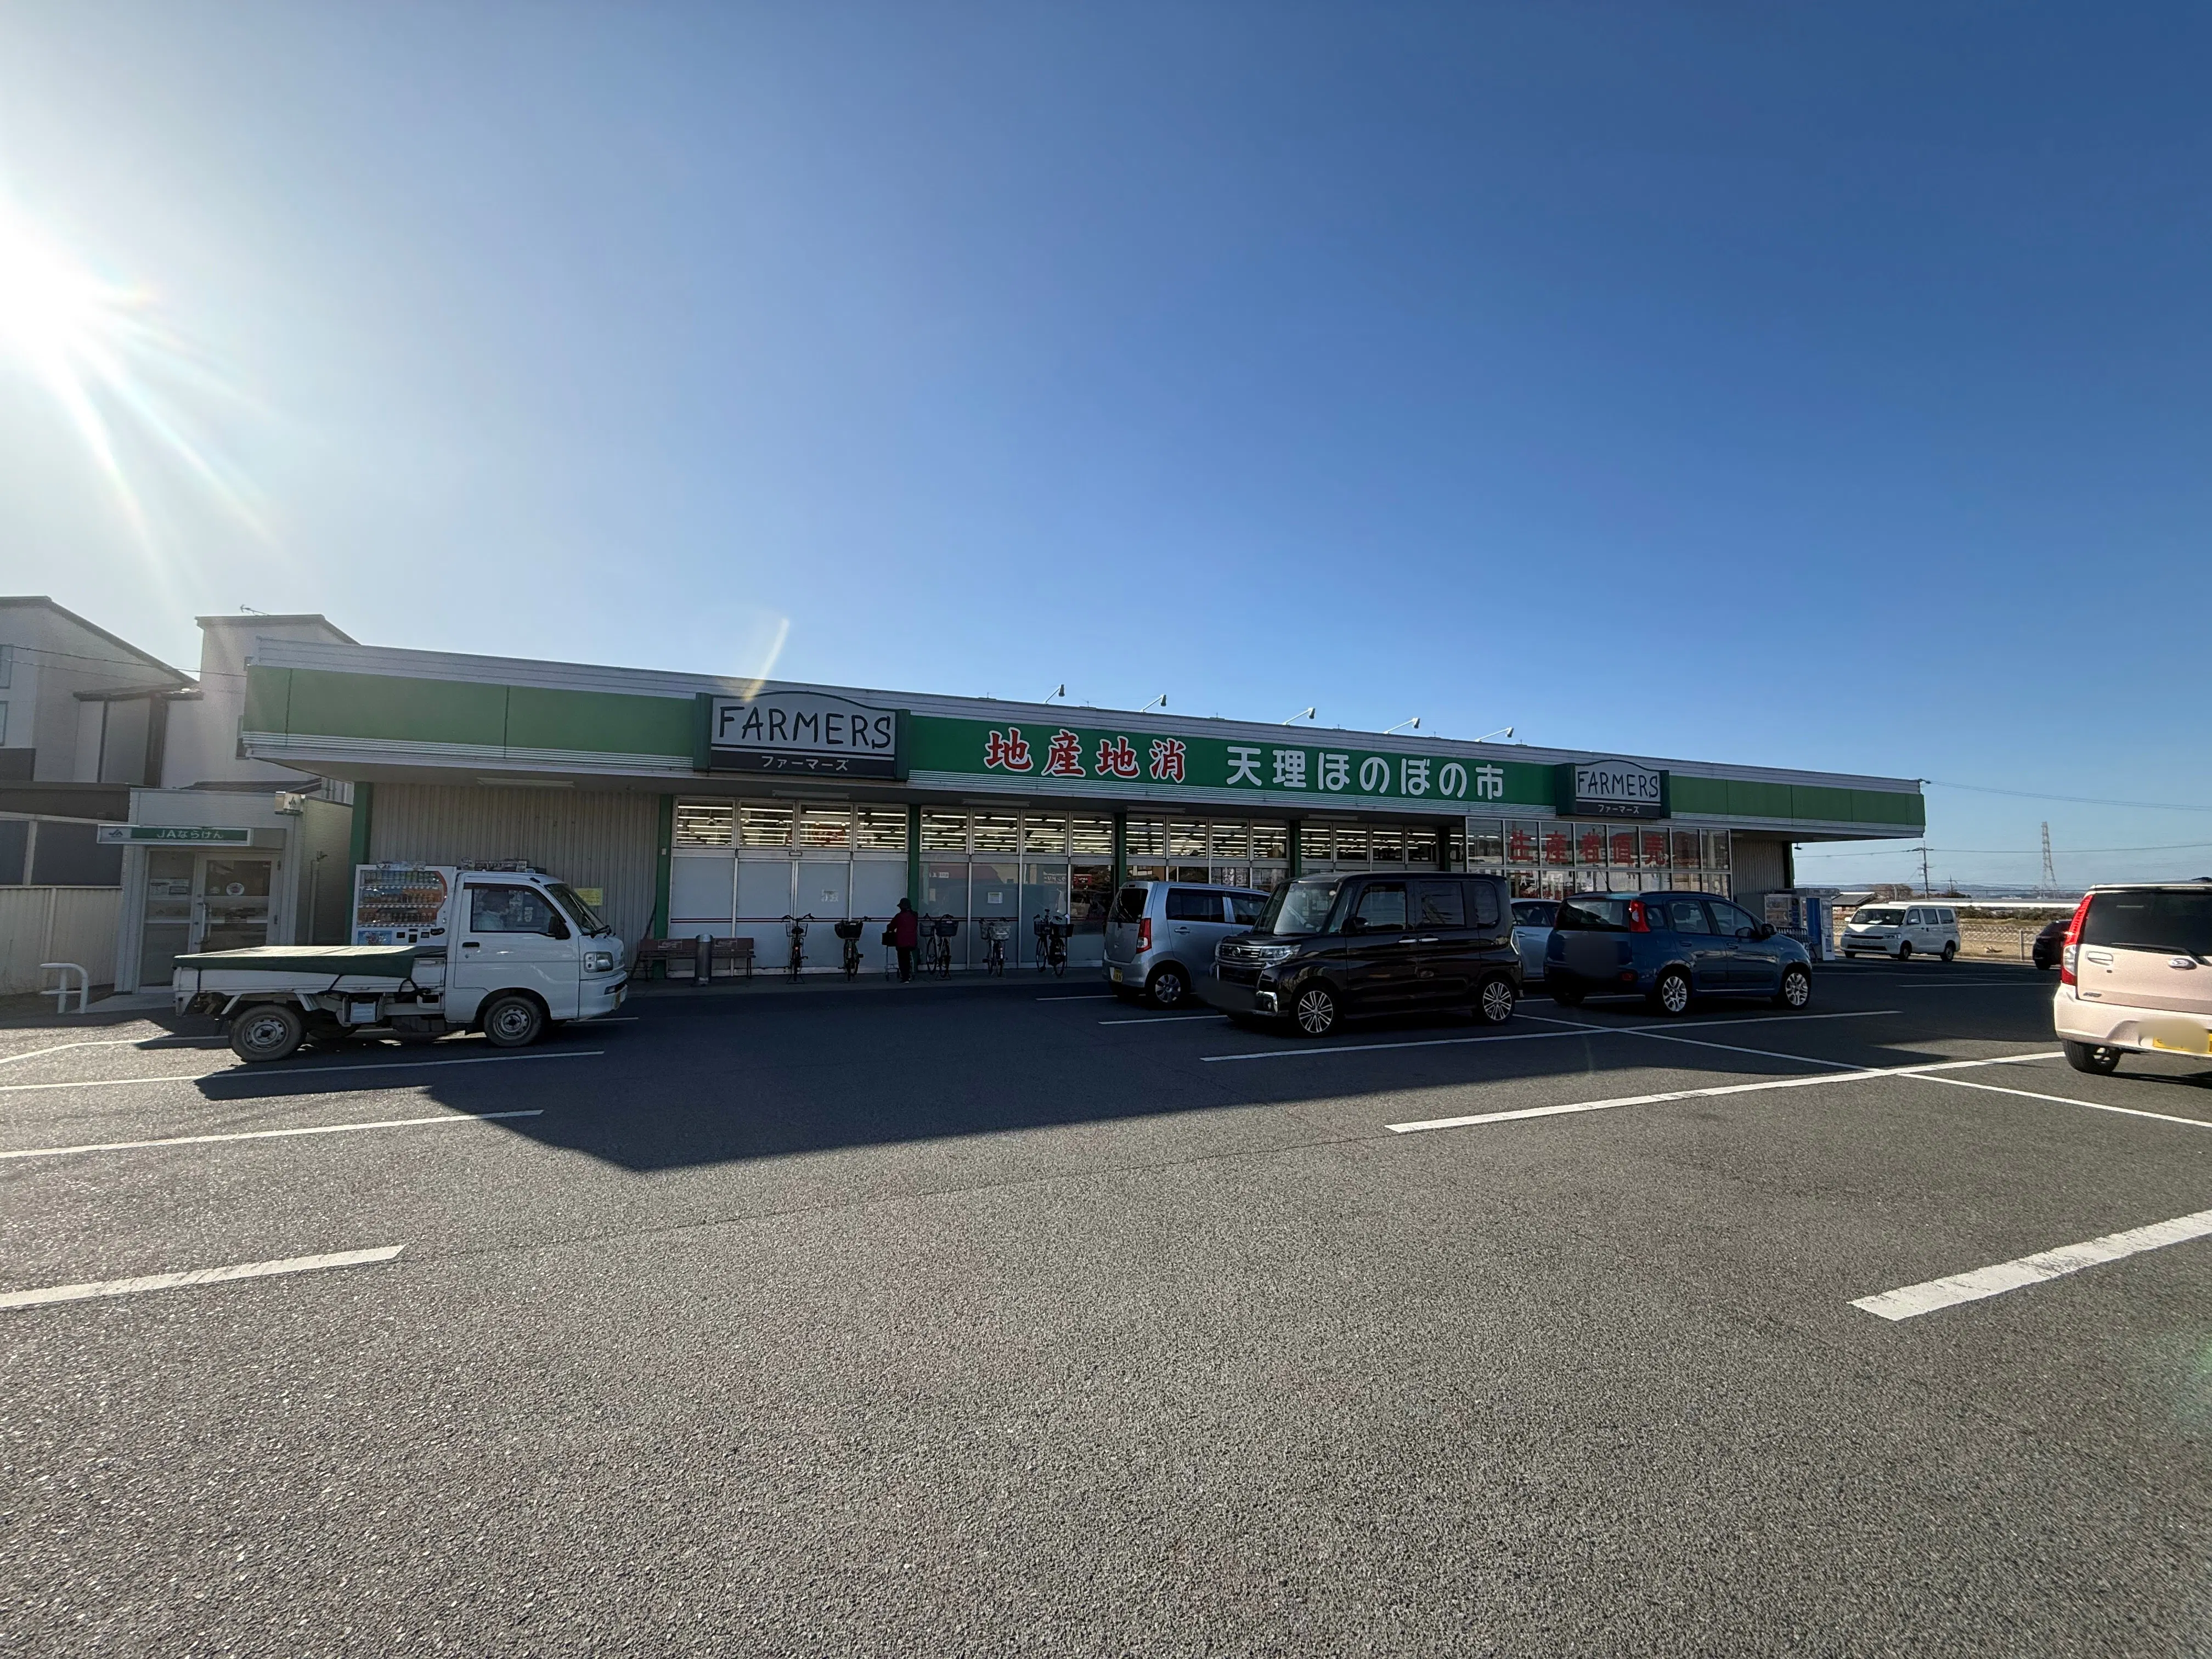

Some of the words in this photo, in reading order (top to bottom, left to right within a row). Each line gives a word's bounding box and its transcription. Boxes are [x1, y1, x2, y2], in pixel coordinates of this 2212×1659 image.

[719, 706, 891, 749] FARMERS
[761, 755, 849, 772] ファーマーズ
[983, 726, 1187, 784] 地産地消
[1226, 746, 1504, 800] 天理ほのぼの市
[1577, 771, 1659, 799] FARMERS
[1598, 804, 1640, 814] ファーマーズ
[156, 829, 224, 839] JAならけん
[1509, 829, 1667, 865] 生産者直売
